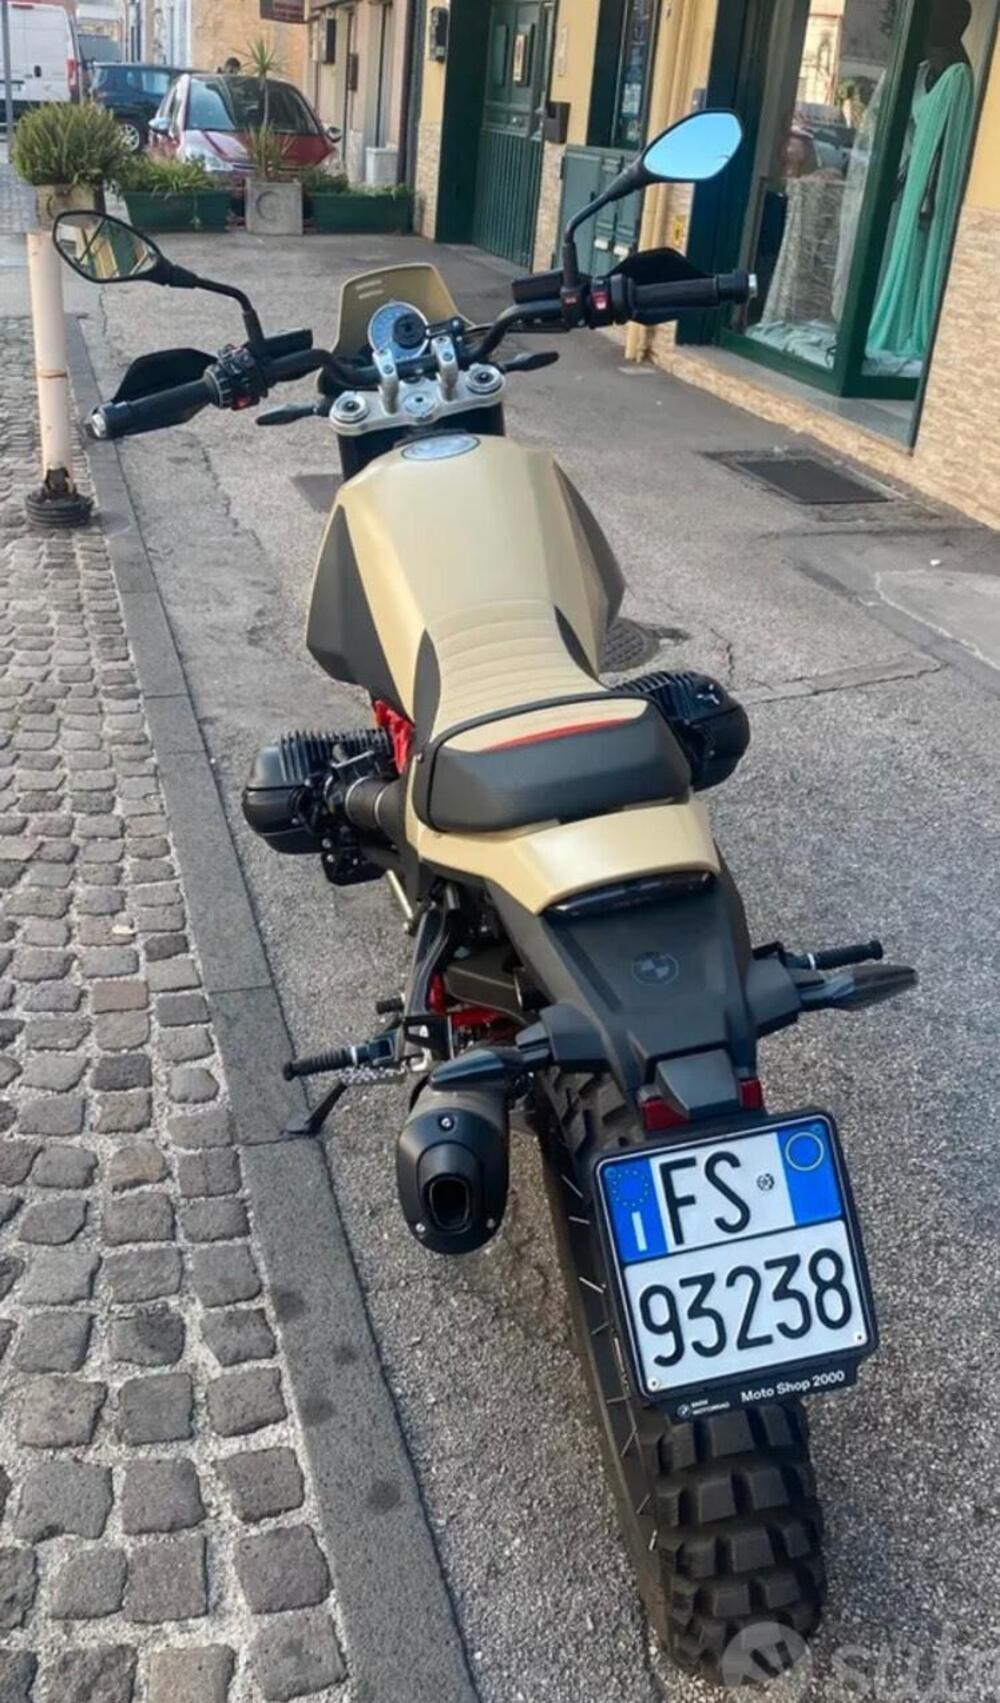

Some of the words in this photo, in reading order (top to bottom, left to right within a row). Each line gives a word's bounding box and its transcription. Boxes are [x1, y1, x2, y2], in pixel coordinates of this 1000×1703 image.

[659, 1151, 751, 1245] FS
[639, 1248, 852, 1368] 93238
[741, 1387, 774, 1403] Moto
[776, 1374, 810, 1395] Shop
[812, 1370, 845, 1387] 2000
